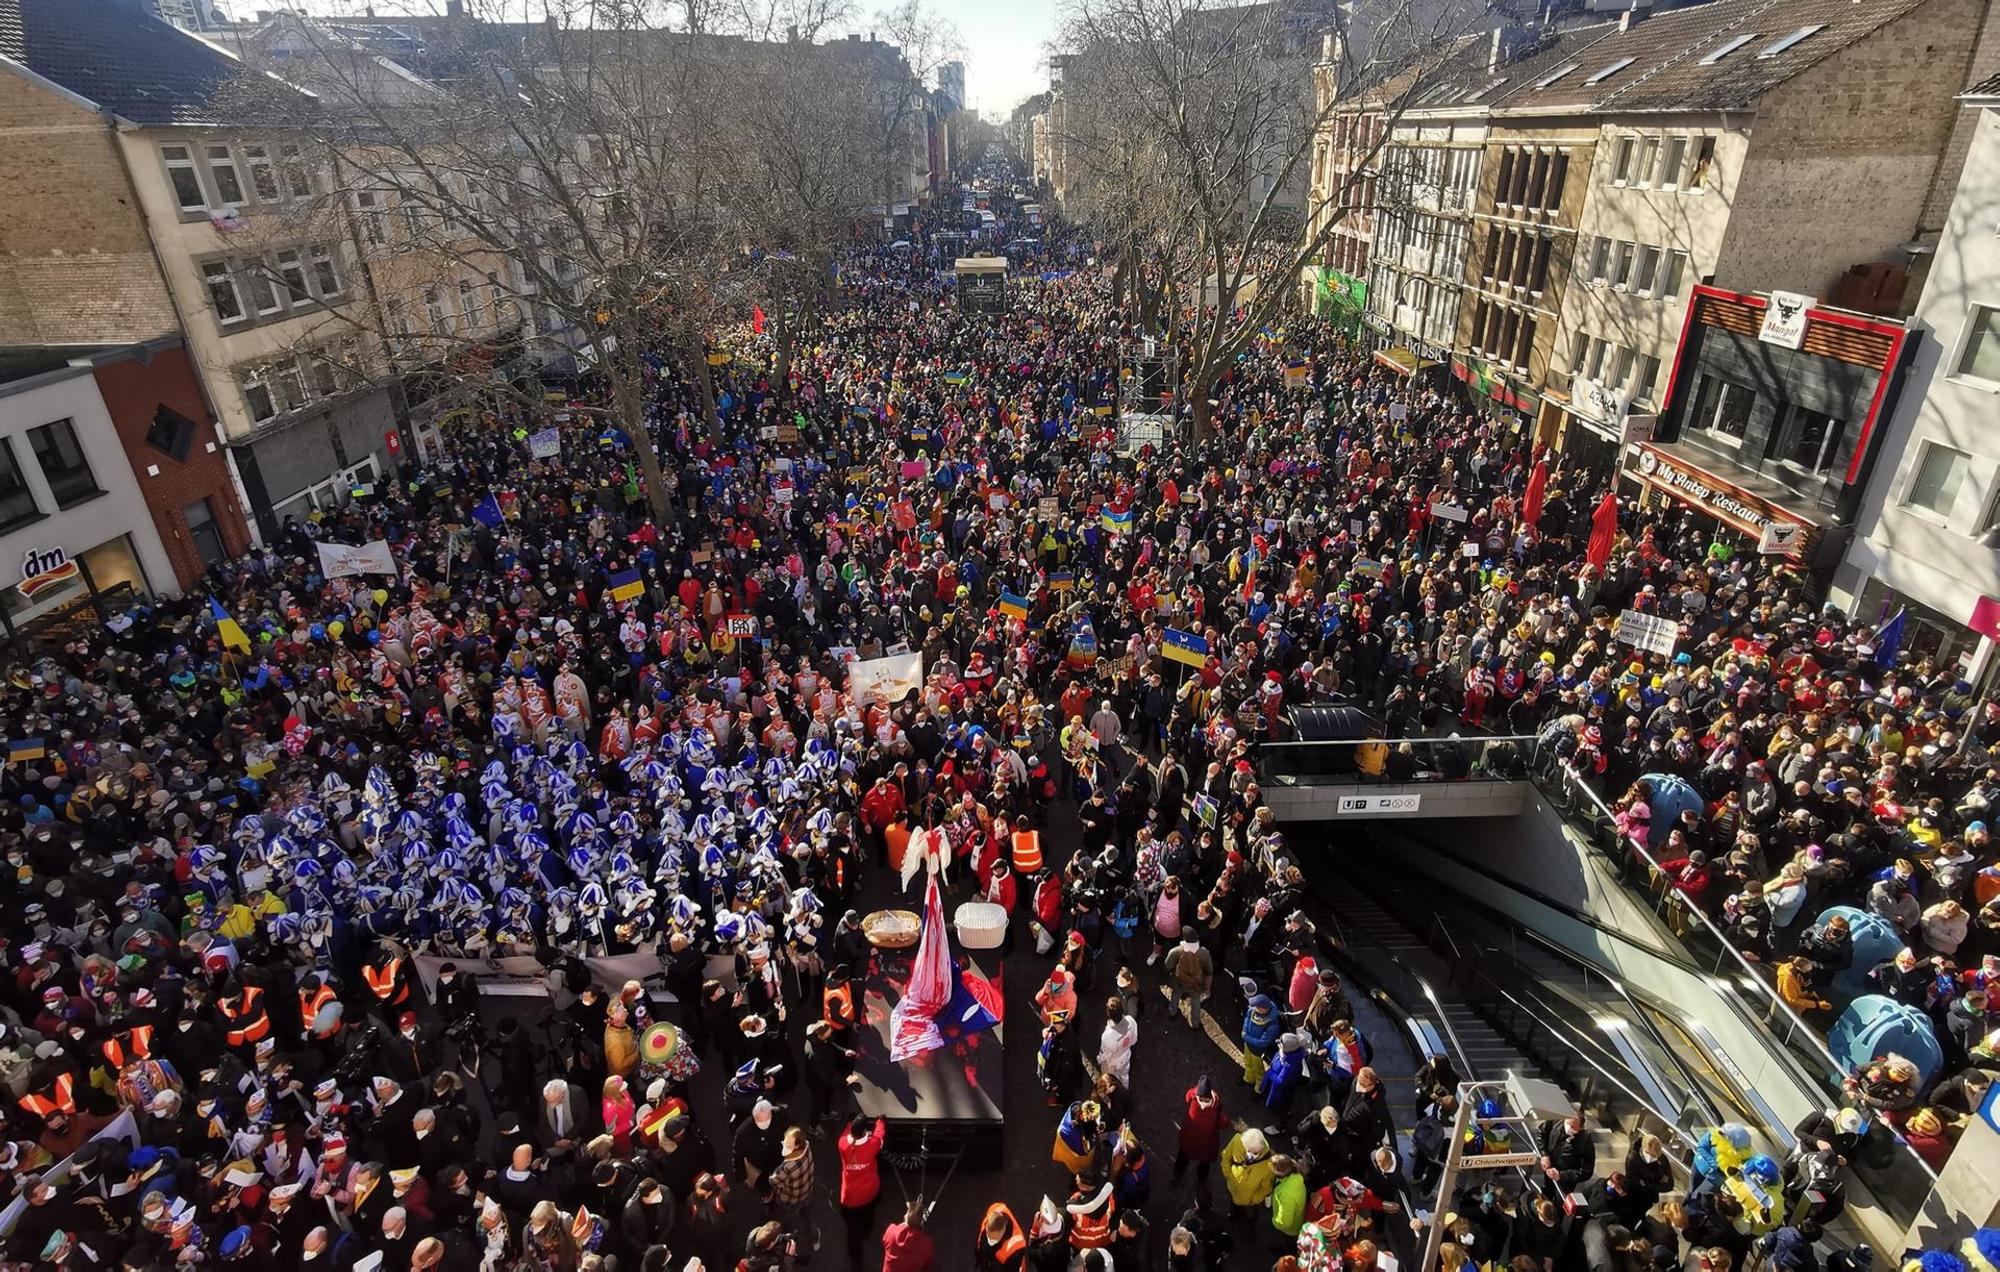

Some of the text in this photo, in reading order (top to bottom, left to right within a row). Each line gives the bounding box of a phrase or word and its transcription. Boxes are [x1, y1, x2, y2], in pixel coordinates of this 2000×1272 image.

[977, 279, 984, 287] U
[1767, 322, 1799, 337] Mangal
[1656, 463, 1774, 528] My Antep Restaura
[24, 548, 65, 578] dm
[1343, 800, 1354, 810] U
[1462, 1158, 1533, 1167] U Chlodwigplatz
